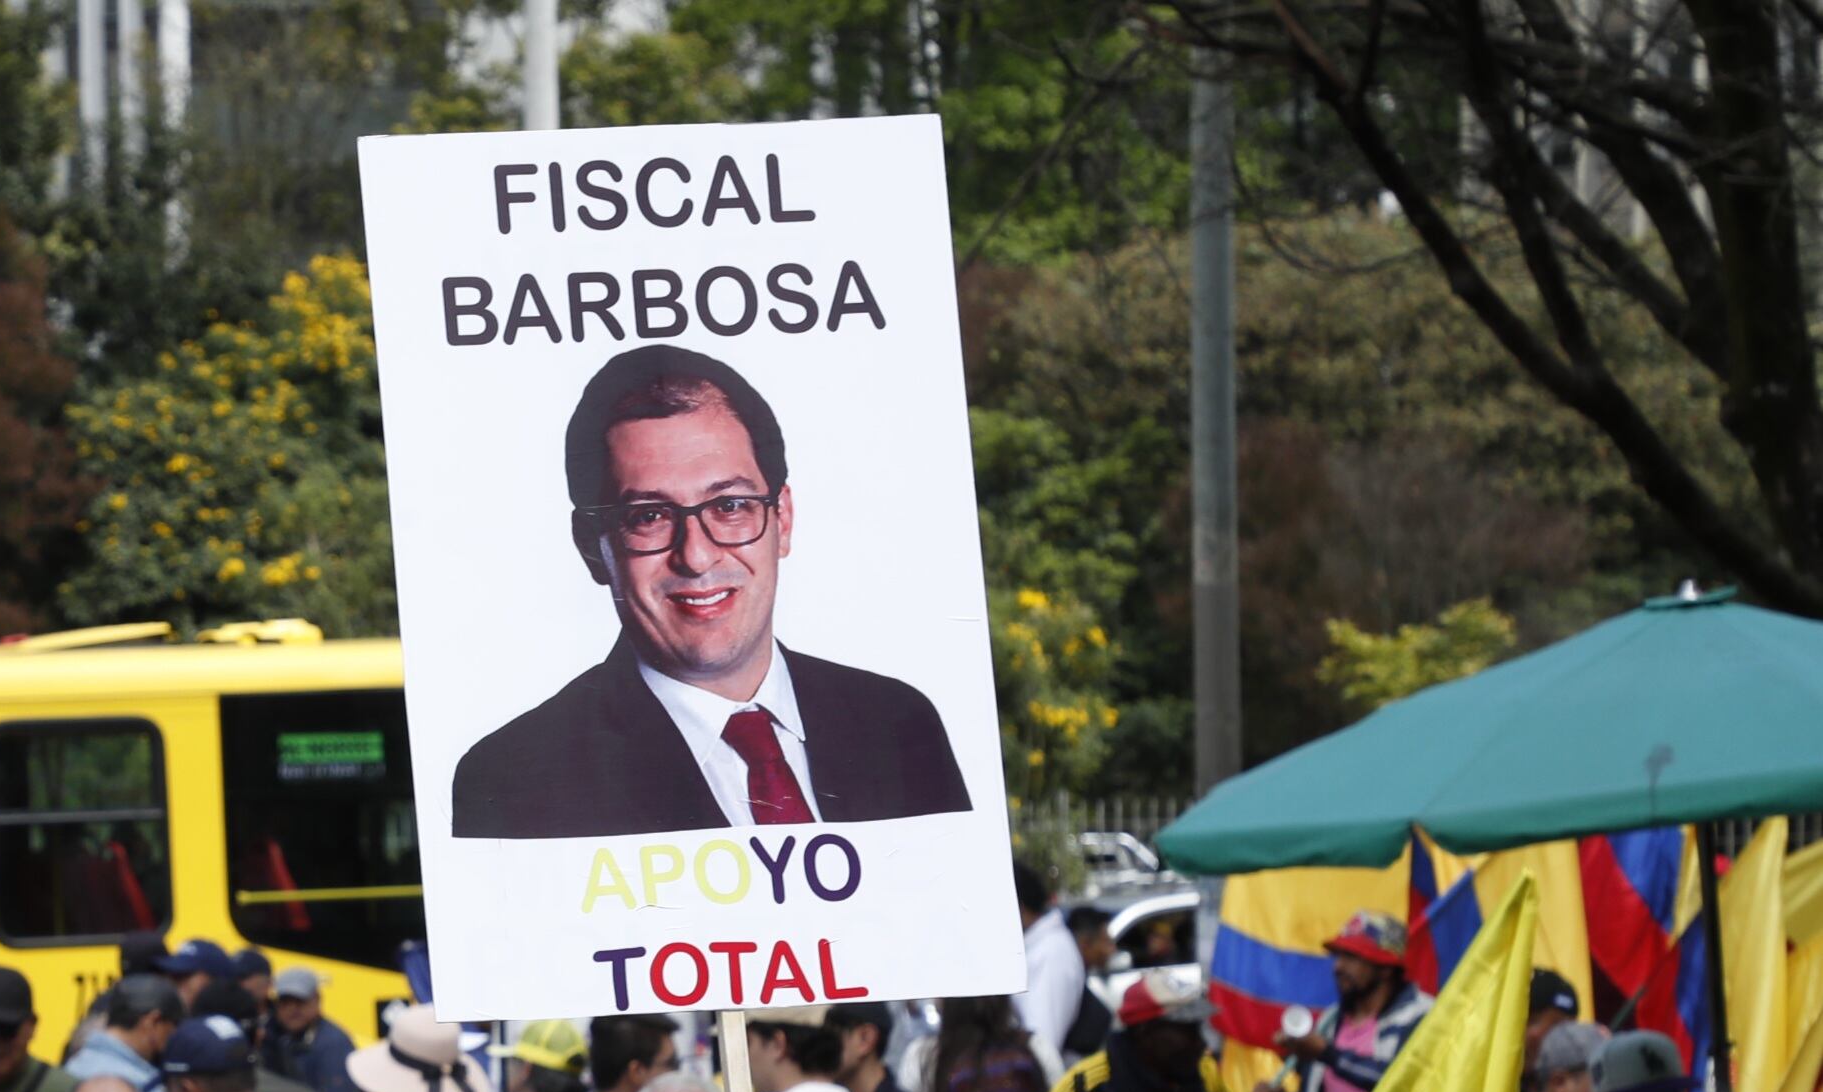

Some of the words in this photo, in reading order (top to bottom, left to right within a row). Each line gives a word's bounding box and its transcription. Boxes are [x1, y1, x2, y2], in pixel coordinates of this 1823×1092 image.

[493, 153, 817, 235] FISCAL
[441, 260, 887, 347] BARBOSA
[581, 833, 863, 914] APOYO
[593, 938, 870, 1011] TOTAL
